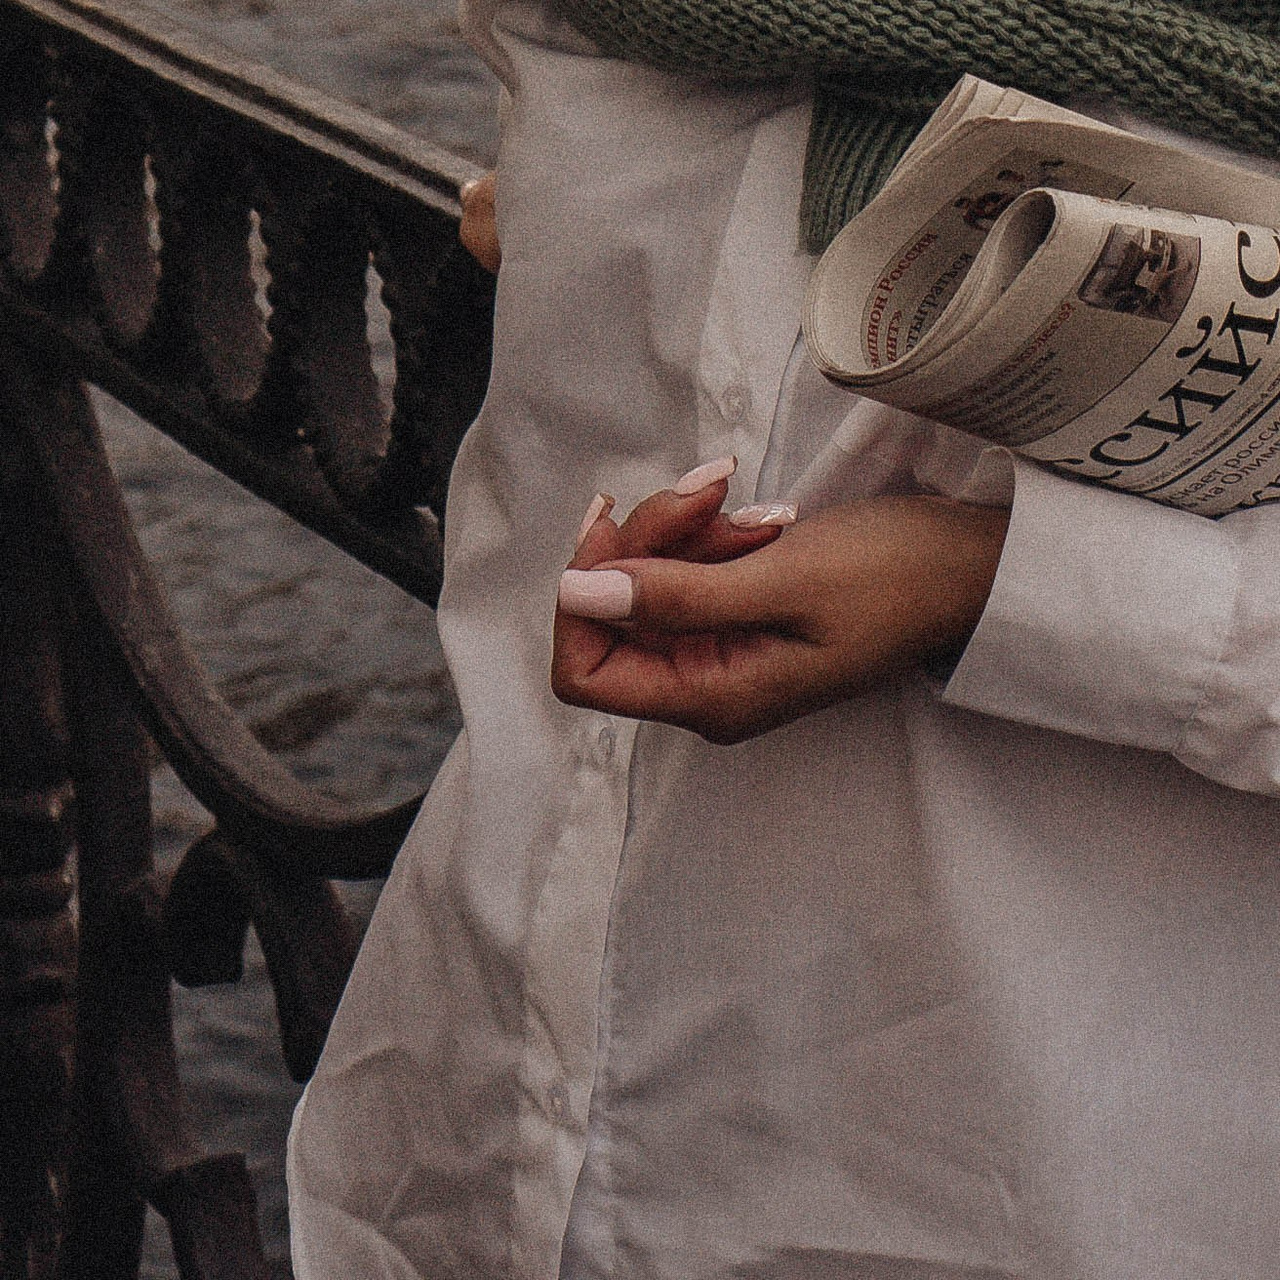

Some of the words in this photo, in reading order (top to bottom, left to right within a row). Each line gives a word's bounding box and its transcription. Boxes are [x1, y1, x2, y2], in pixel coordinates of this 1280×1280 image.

[877, 233, 938, 293] России
[906, 253, 973, 352] отыграться
[1197, 486, 1225, 502] на
